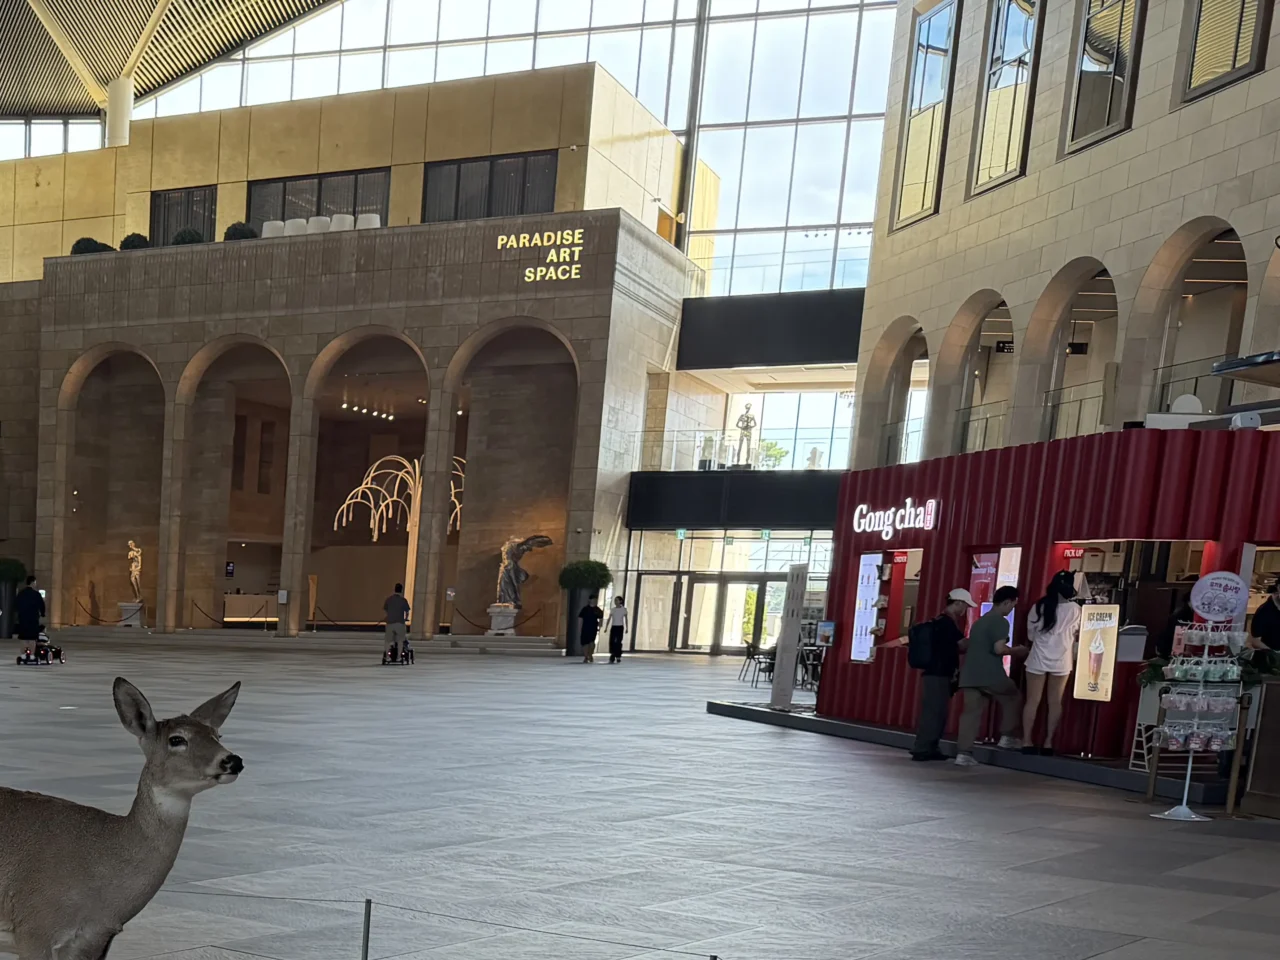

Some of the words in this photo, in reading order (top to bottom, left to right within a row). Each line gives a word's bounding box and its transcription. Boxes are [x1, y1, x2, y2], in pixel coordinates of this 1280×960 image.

[497, 228, 585, 250] PARADISE
[546, 247, 584, 263] ART
[524, 264, 582, 282] SPACE
[853, 504, 896, 540] Gong
[895, 497, 925, 529] cha
